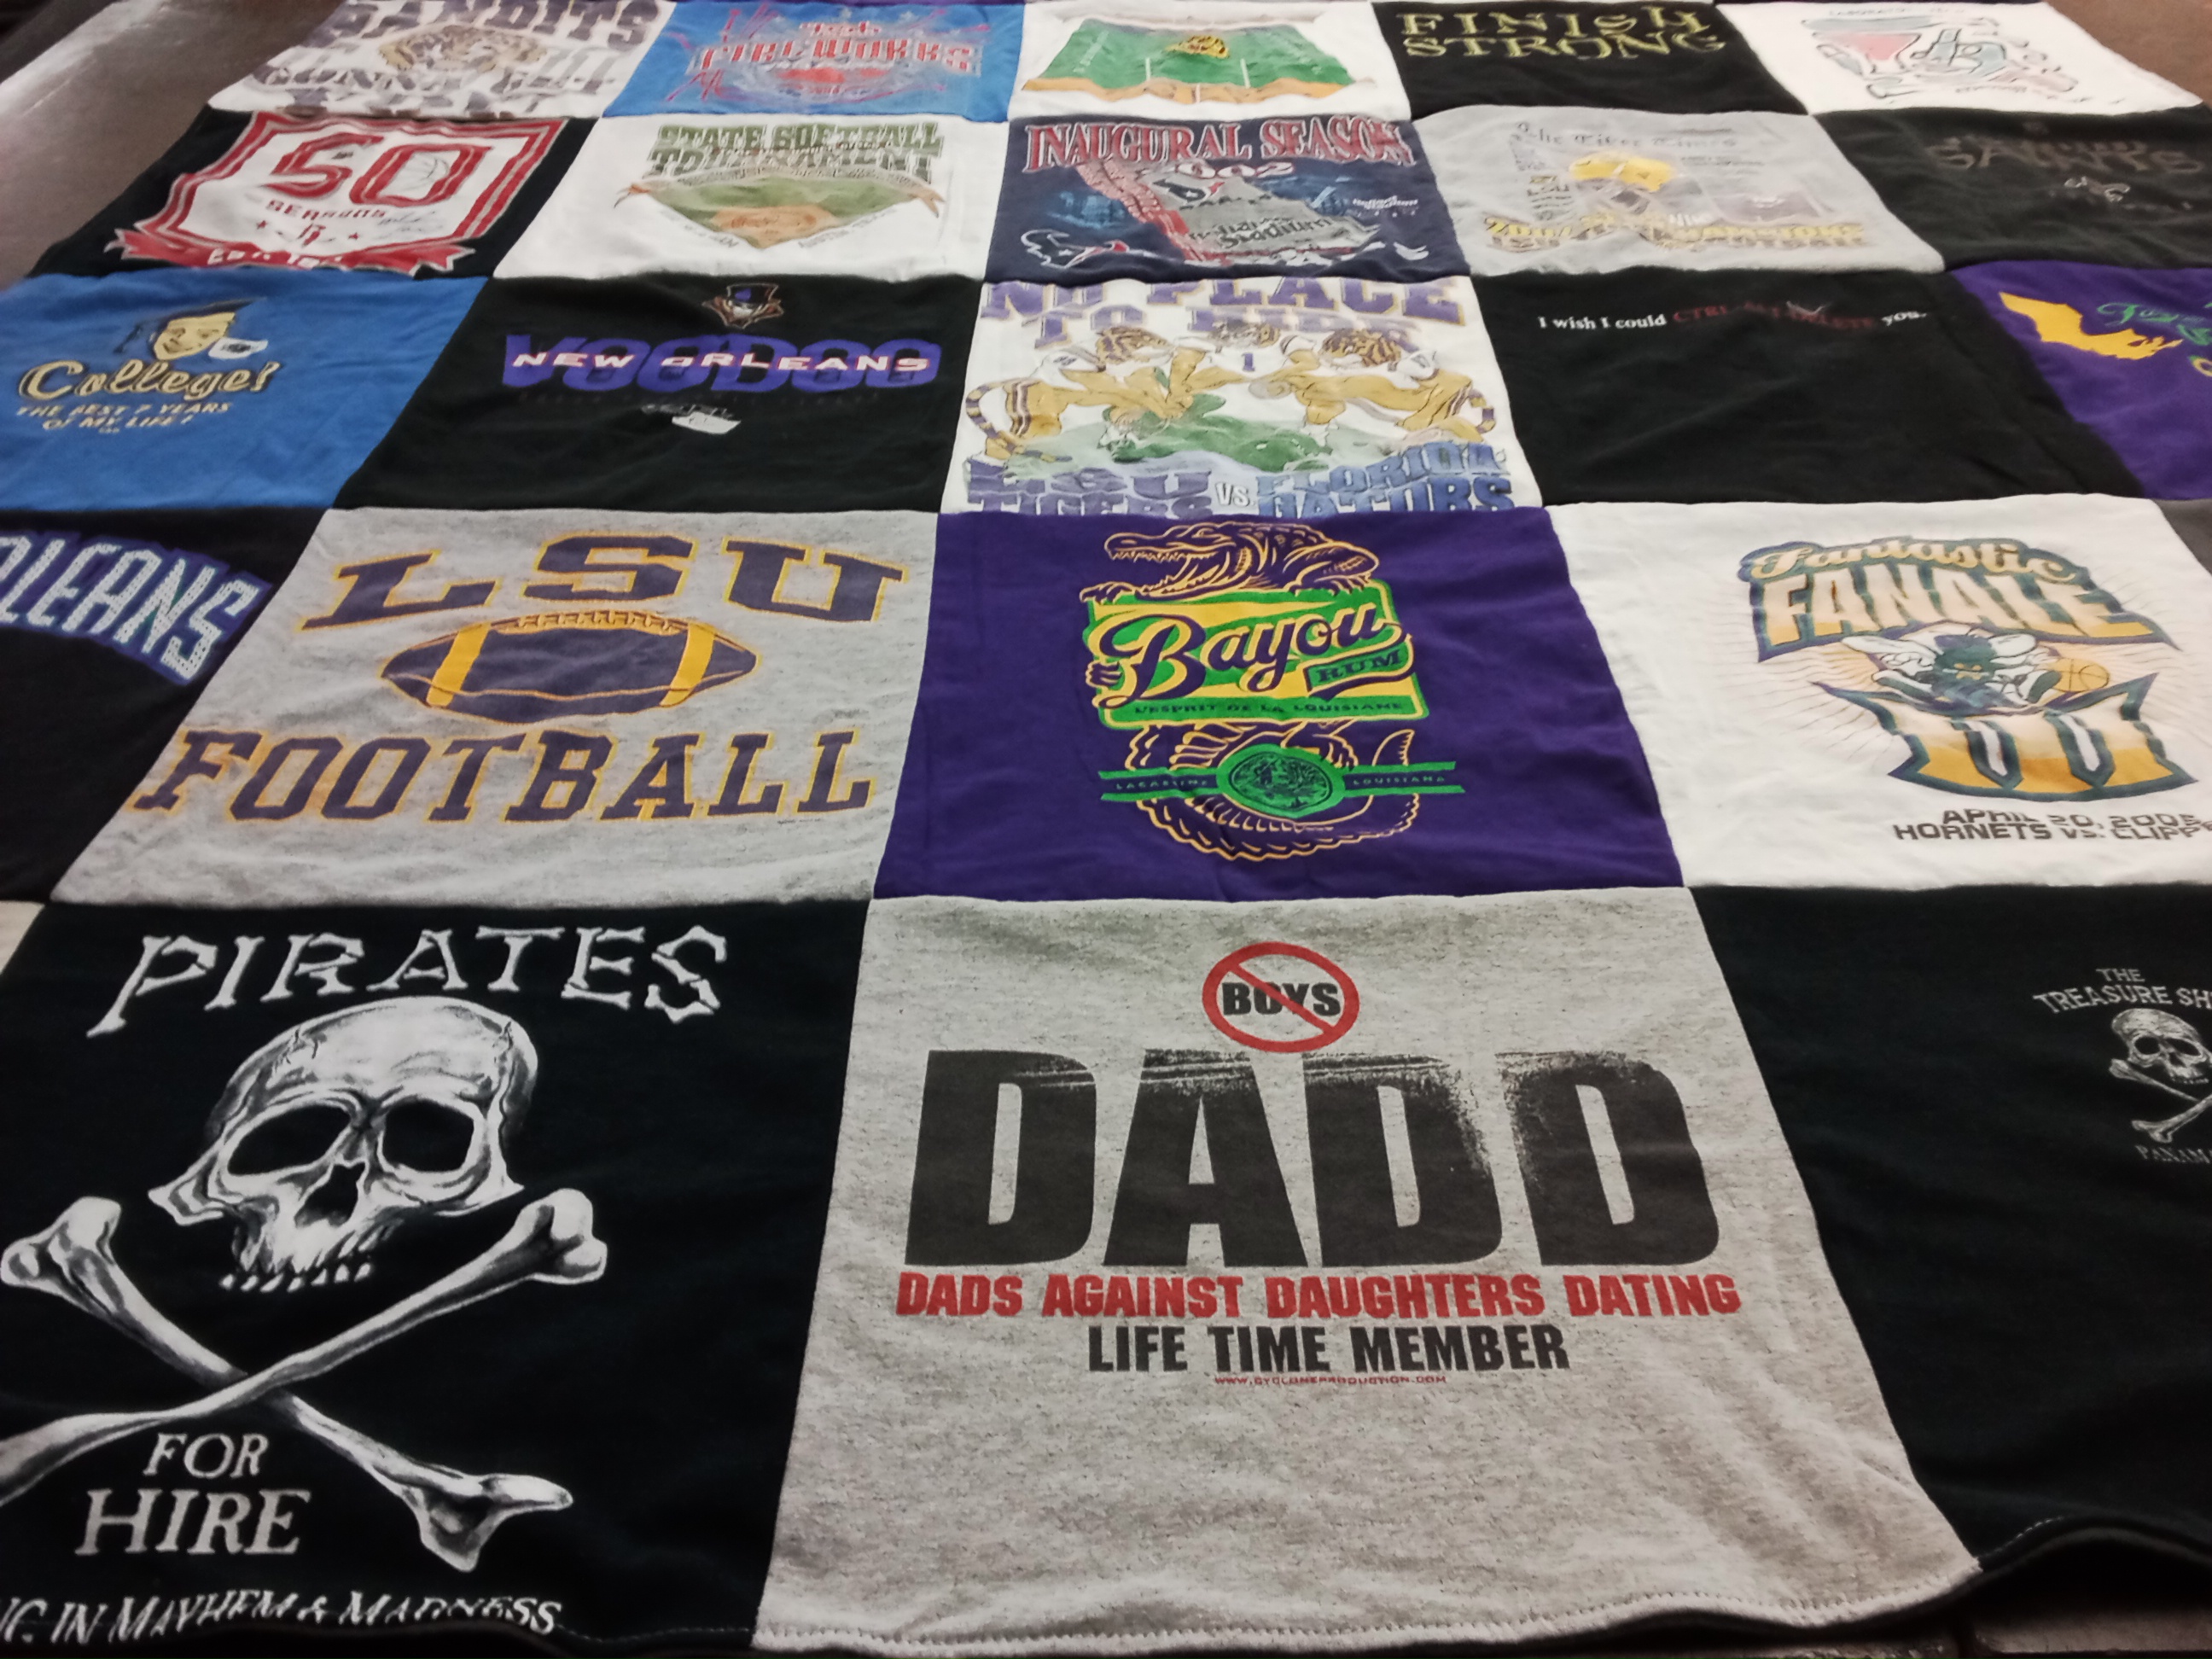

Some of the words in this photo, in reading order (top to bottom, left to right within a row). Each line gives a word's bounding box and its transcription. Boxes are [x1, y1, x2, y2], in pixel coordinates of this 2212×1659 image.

[1397, 6, 1709, 39] FINISH
[1402, 31, 1726, 60] STRONG
[1023, 123, 1253, 173] INAUGURAL
[1260, 114, 1416, 166] SEASON
[263, 131, 493, 207] 50
[1539, 317, 1546, 328] I
[1552, 317, 1596, 329] wish
[1601, 317, 1610, 329] I
[1615, 314, 1667, 329] could
[502, 334, 940, 393] VOODOO
[513, 352, 636, 369] NEW
[660, 352, 930, 372] ORLEANS
[1741, 536, 2079, 583] Fantastic
[299, 535, 905, 632] LSU
[0, 535, 259, 681] LEANS
[1089, 602, 1389, 709] Bayou
[1314, 648, 1402, 684] RUM
[1227, 704, 1259, 713] DE
[130, 726, 879, 824] FOOTBALL
[1893, 822, 2052, 841] HORNETS
[1941, 809, 2040, 824] APRIL
[2050, 814, 2103, 830] 20,
[87, 926, 727, 1038] PIRATES
[2096, 968, 2145, 982] THE
[1222, 981, 1342, 1019] BOYS
[2032, 984, 2173, 1013] TREASURE
[2175, 987, 2212, 1010] SH
[905, 1047, 1720, 1268] DADD
[895, 1273, 1023, 1317] DADS
[1041, 1274, 1243, 1318] AGAINST
[1266, 1274, 1544, 1318] DAUGHTERS
[1562, 1274, 1742, 1315] DATING
[1087, 1325, 1189, 1372] LIFE
[1206, 1325, 1330, 1372] TIME
[1353, 1324, 1570, 1371] MEMBER
[143, 1433, 269, 1479] FOR
[75, 1488, 311, 1556] HIRE
[50, 1602, 108, 1644] IN
[108, 1589, 299, 1643] MAYHEM
[339, 1591, 562, 1635] MADNESS
